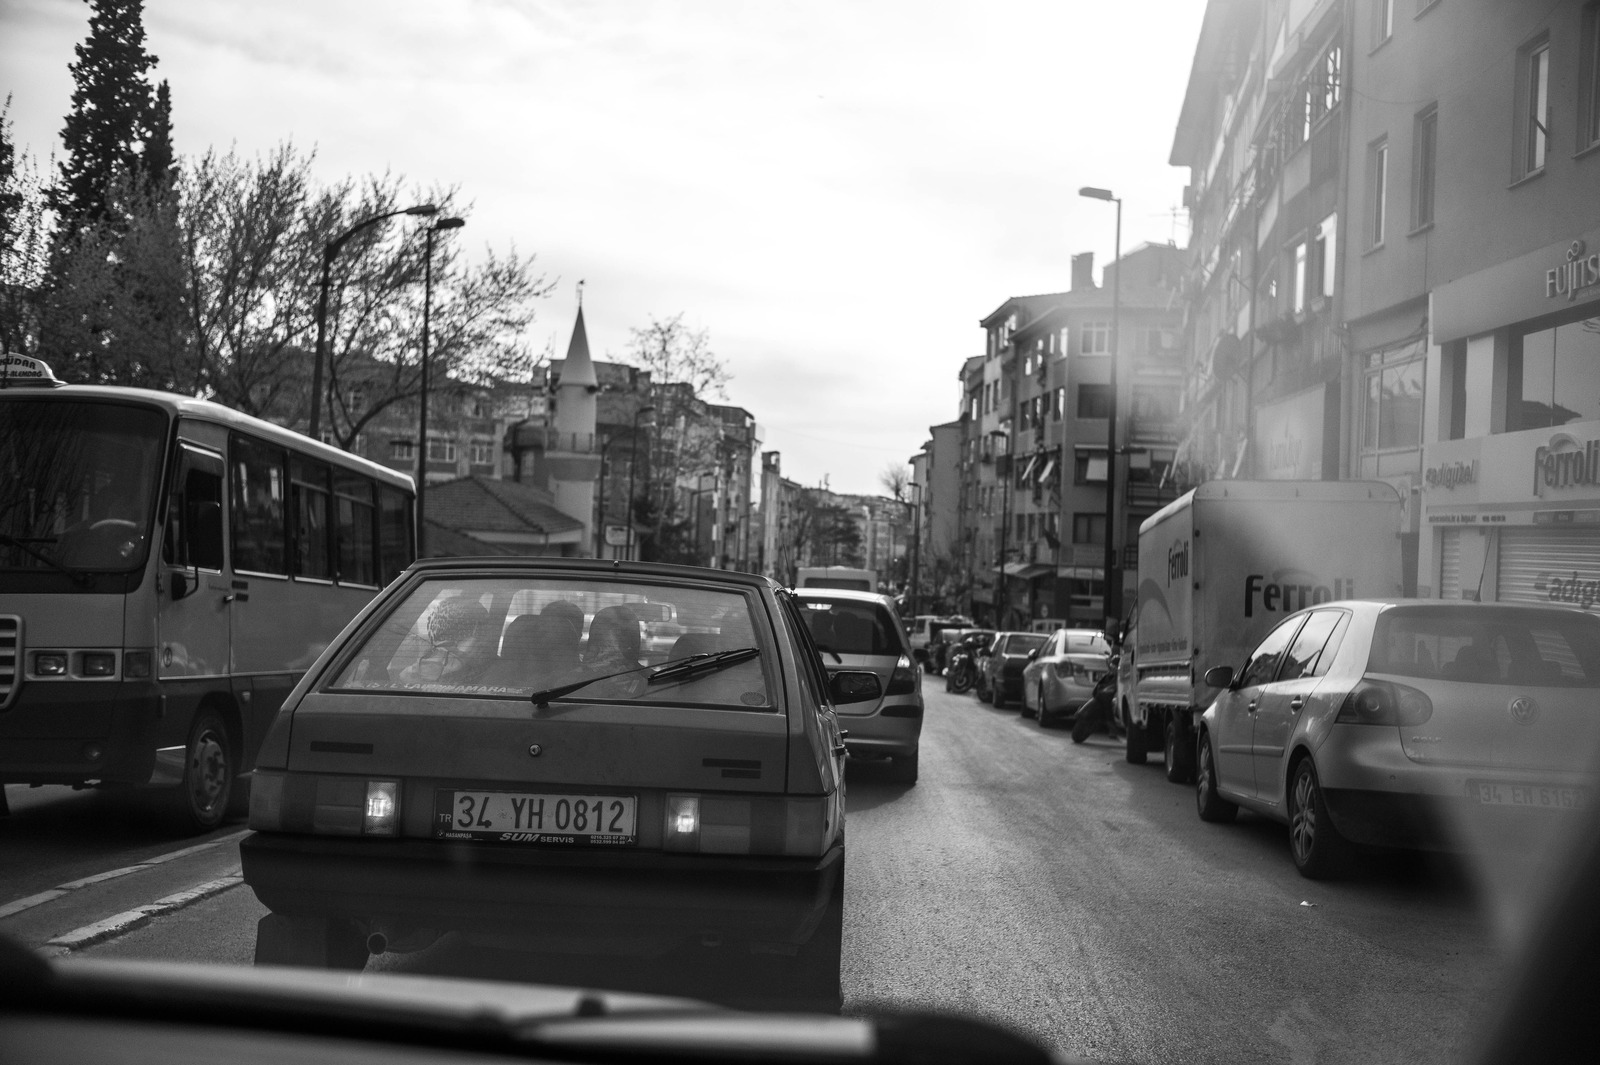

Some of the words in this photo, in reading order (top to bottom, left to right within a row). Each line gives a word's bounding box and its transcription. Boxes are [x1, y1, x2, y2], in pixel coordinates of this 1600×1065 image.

[1545, 253, 1600, 299] FUJITS
[1245, 574, 1354, 618] Ferroli
[1481, 784, 1503, 803] 34
[439, 813, 452, 823] TR
[457, 795, 492, 829] 34
[511, 797, 545, 829] YH
[555, 798, 626, 833] 0812
[500, 833, 541, 842] SUM
